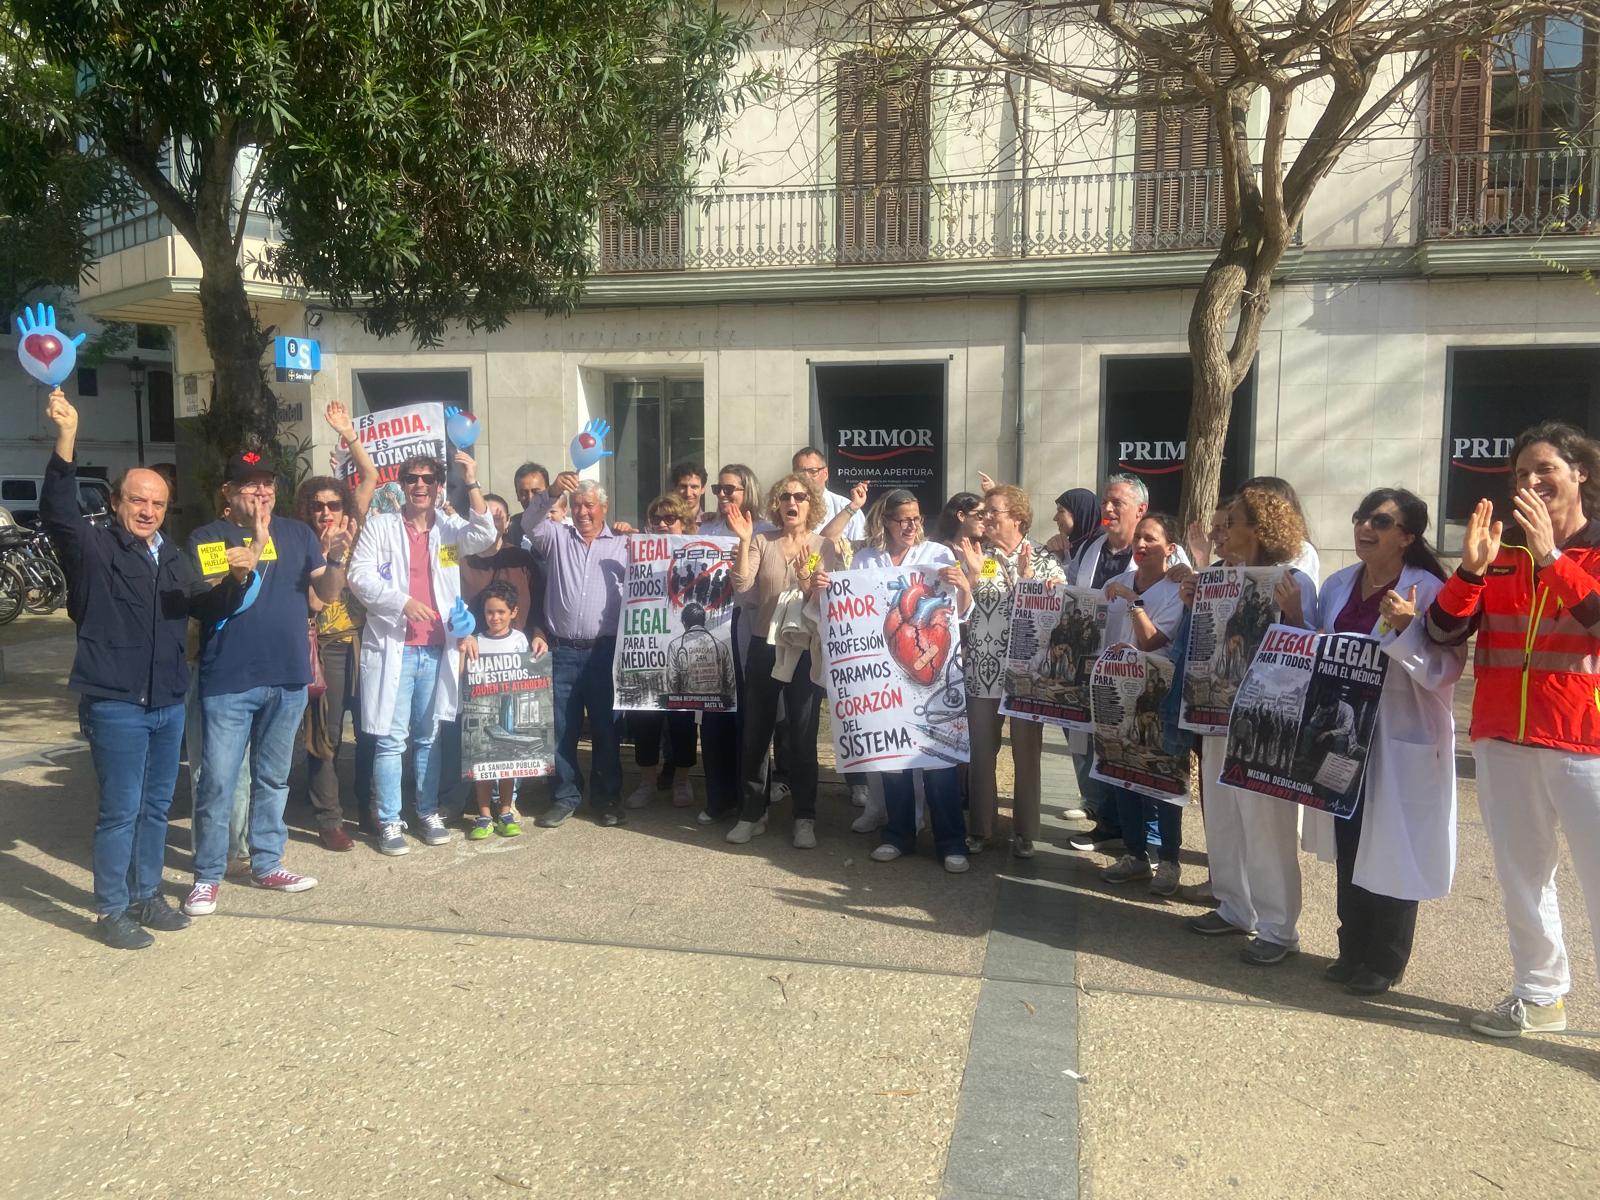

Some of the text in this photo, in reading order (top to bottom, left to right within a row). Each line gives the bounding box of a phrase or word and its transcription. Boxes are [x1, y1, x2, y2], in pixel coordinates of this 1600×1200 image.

[376, 438, 389, 450] ES
[838, 428, 934, 447] PRIMOR
[1119, 441, 1187, 461] PRIM
[838, 467, 934, 476] PRÓXIMA APERTURA
[210, 552, 219, 560] EN
[630, 563, 653, 581] PARA
[1199, 569, 1225, 585] TENGO
[826, 578, 855, 600] POR
[1019, 582, 1043, 595] TENGO
[1196, 583, 1241, 602] 5 MINUTOS
[827, 595, 880, 623] AMOR
[1016, 595, 1061, 612] 5 MINUTOS
[624, 607, 671, 636] LEGAL
[1015, 608, 1035, 619] PARA:
[829, 622, 853, 639] A LA
[623, 636, 659, 650] PARA EL
[827, 629, 884, 657] PROFESIÓN
[1261, 631, 1316, 657] ILEGAL
[621, 649, 669, 669] MÉDICO.
[1256, 652, 1313, 673] PARA TODOS,
[1322, 635, 1383, 672] LEGAL
[467, 654, 522, 673] CUANDO
[1095, 660, 1144, 679] 5 MINUTOS
[1317, 661, 1338, 677] PARA
[1340, 666, 1349, 679] EL
[468, 673, 482, 686] NO
[829, 661, 891, 688] PARAMOS
[1094, 674, 1117, 686] PARA:
[835, 683, 903, 720] CORAZÓN
[838, 687, 850, 699] EL
[842, 719, 862, 733] DEL
[839, 726, 917, 760] SISTEMA.
[478, 764, 486, 772] LA
[488, 762, 515, 772] SANIDAD
[500, 769, 510, 778] EN
[512, 768, 539, 777] RIESGO
[1246, 768, 1270, 783] MISMA
